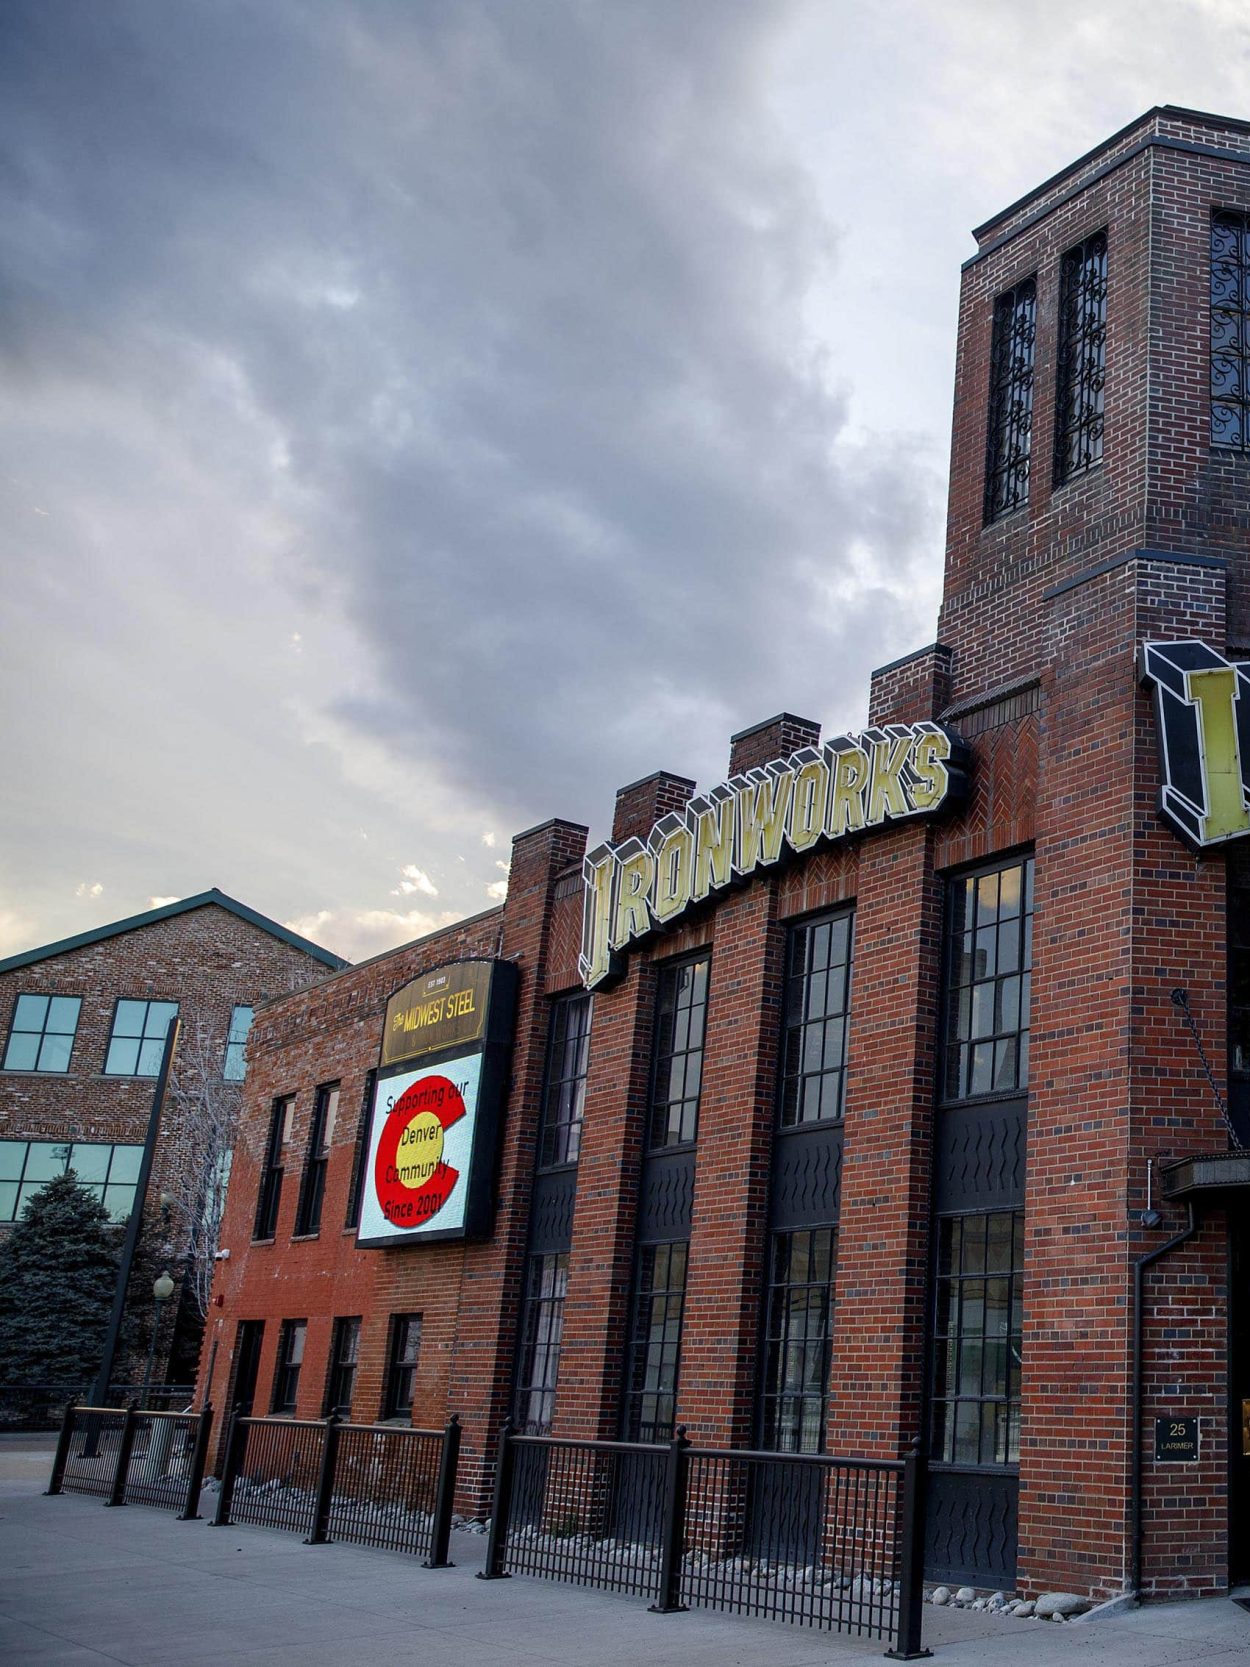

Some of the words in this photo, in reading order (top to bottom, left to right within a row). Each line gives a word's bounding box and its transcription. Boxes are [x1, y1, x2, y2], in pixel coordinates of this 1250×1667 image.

[577, 721, 953, 992] IRONWORKS
[403, 997, 447, 1033] MIDWEST
[446, 987, 476, 1019] STEEL
[385, 1087, 445, 1117] Supporting
[448, 1081, 470, 1100] our
[401, 1124, 442, 1147] Denver
[384, 1156, 450, 1184] Community
[383, 1199, 413, 1220] Since
[416, 1192, 443, 1216] 2001
[1170, 1423, 1186, 1436] 25
